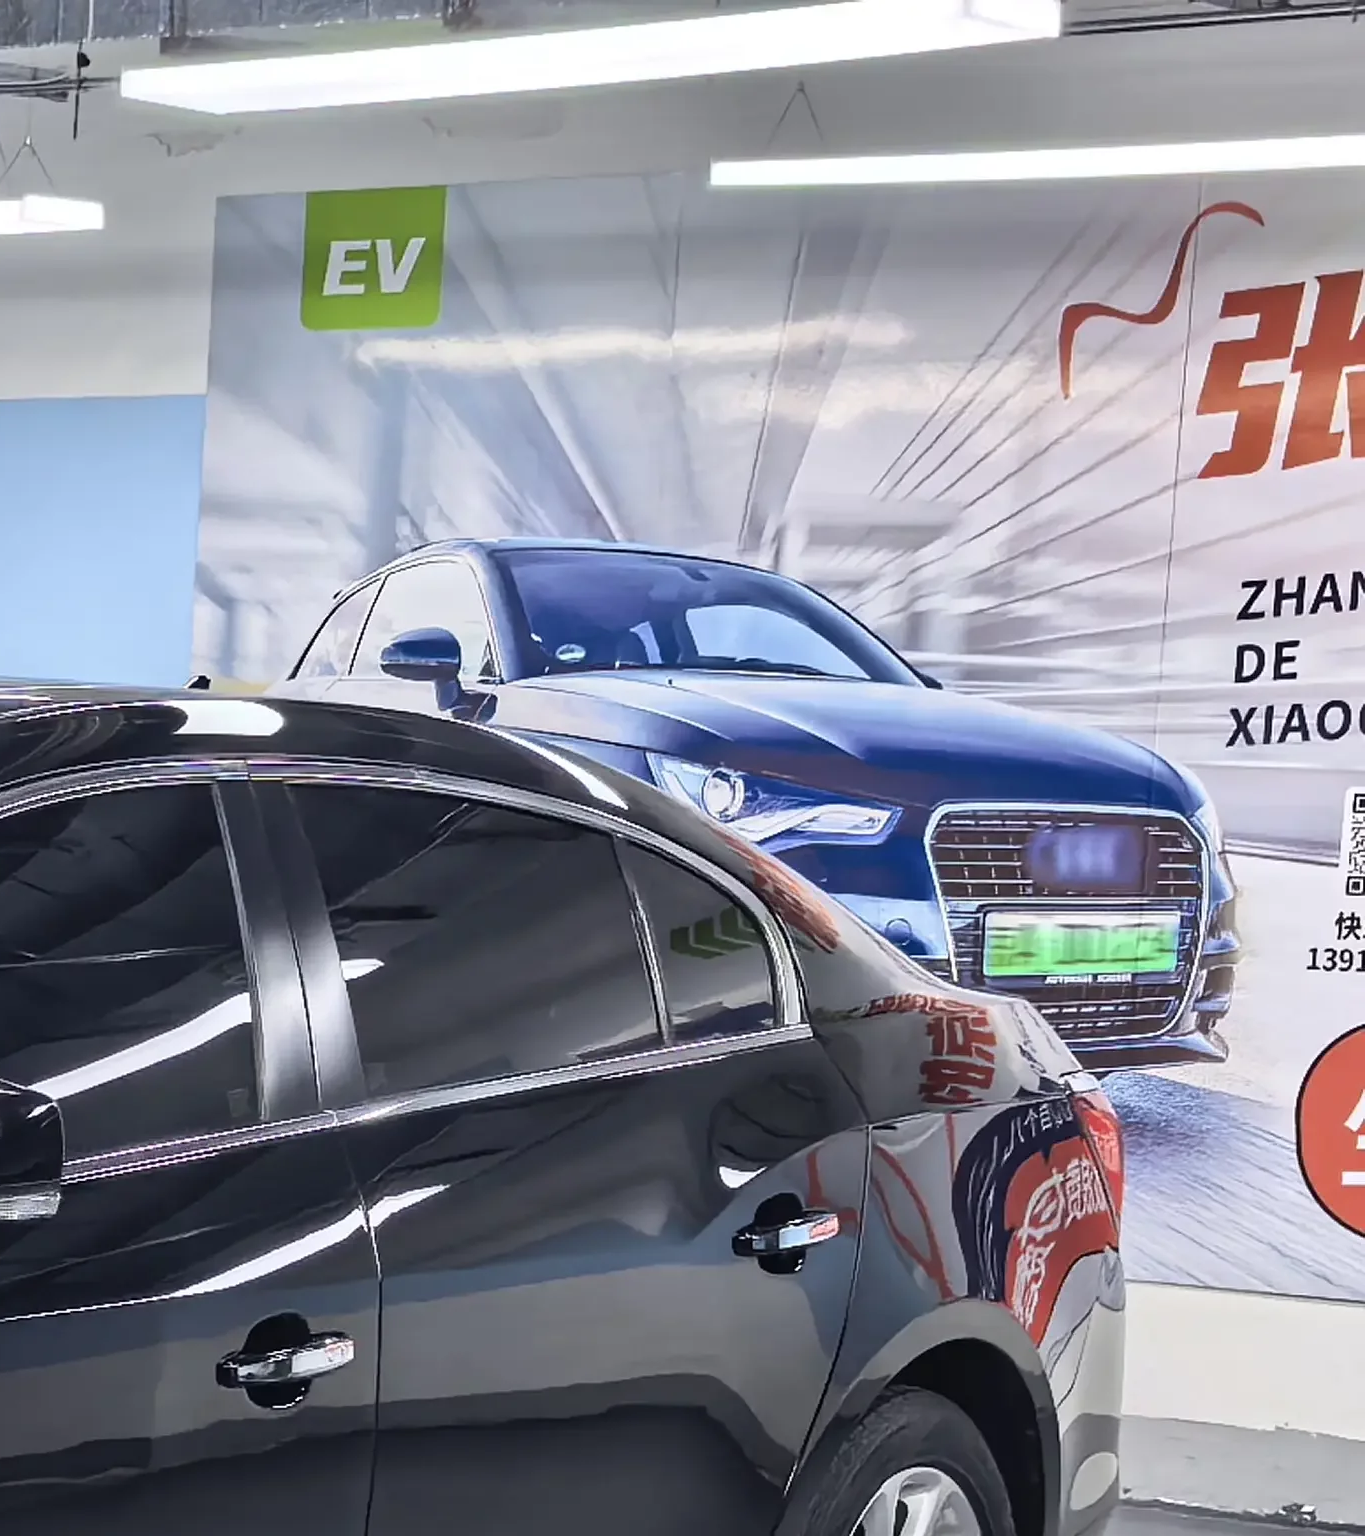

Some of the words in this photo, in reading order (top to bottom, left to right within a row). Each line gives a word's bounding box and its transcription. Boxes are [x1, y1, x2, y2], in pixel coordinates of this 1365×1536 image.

[322, 237, 426, 296] EV
[1234, 640, 1300, 683] DE
[1225, 700, 1365, 748] XIAO
[1335, 911, 1365, 940] 快
